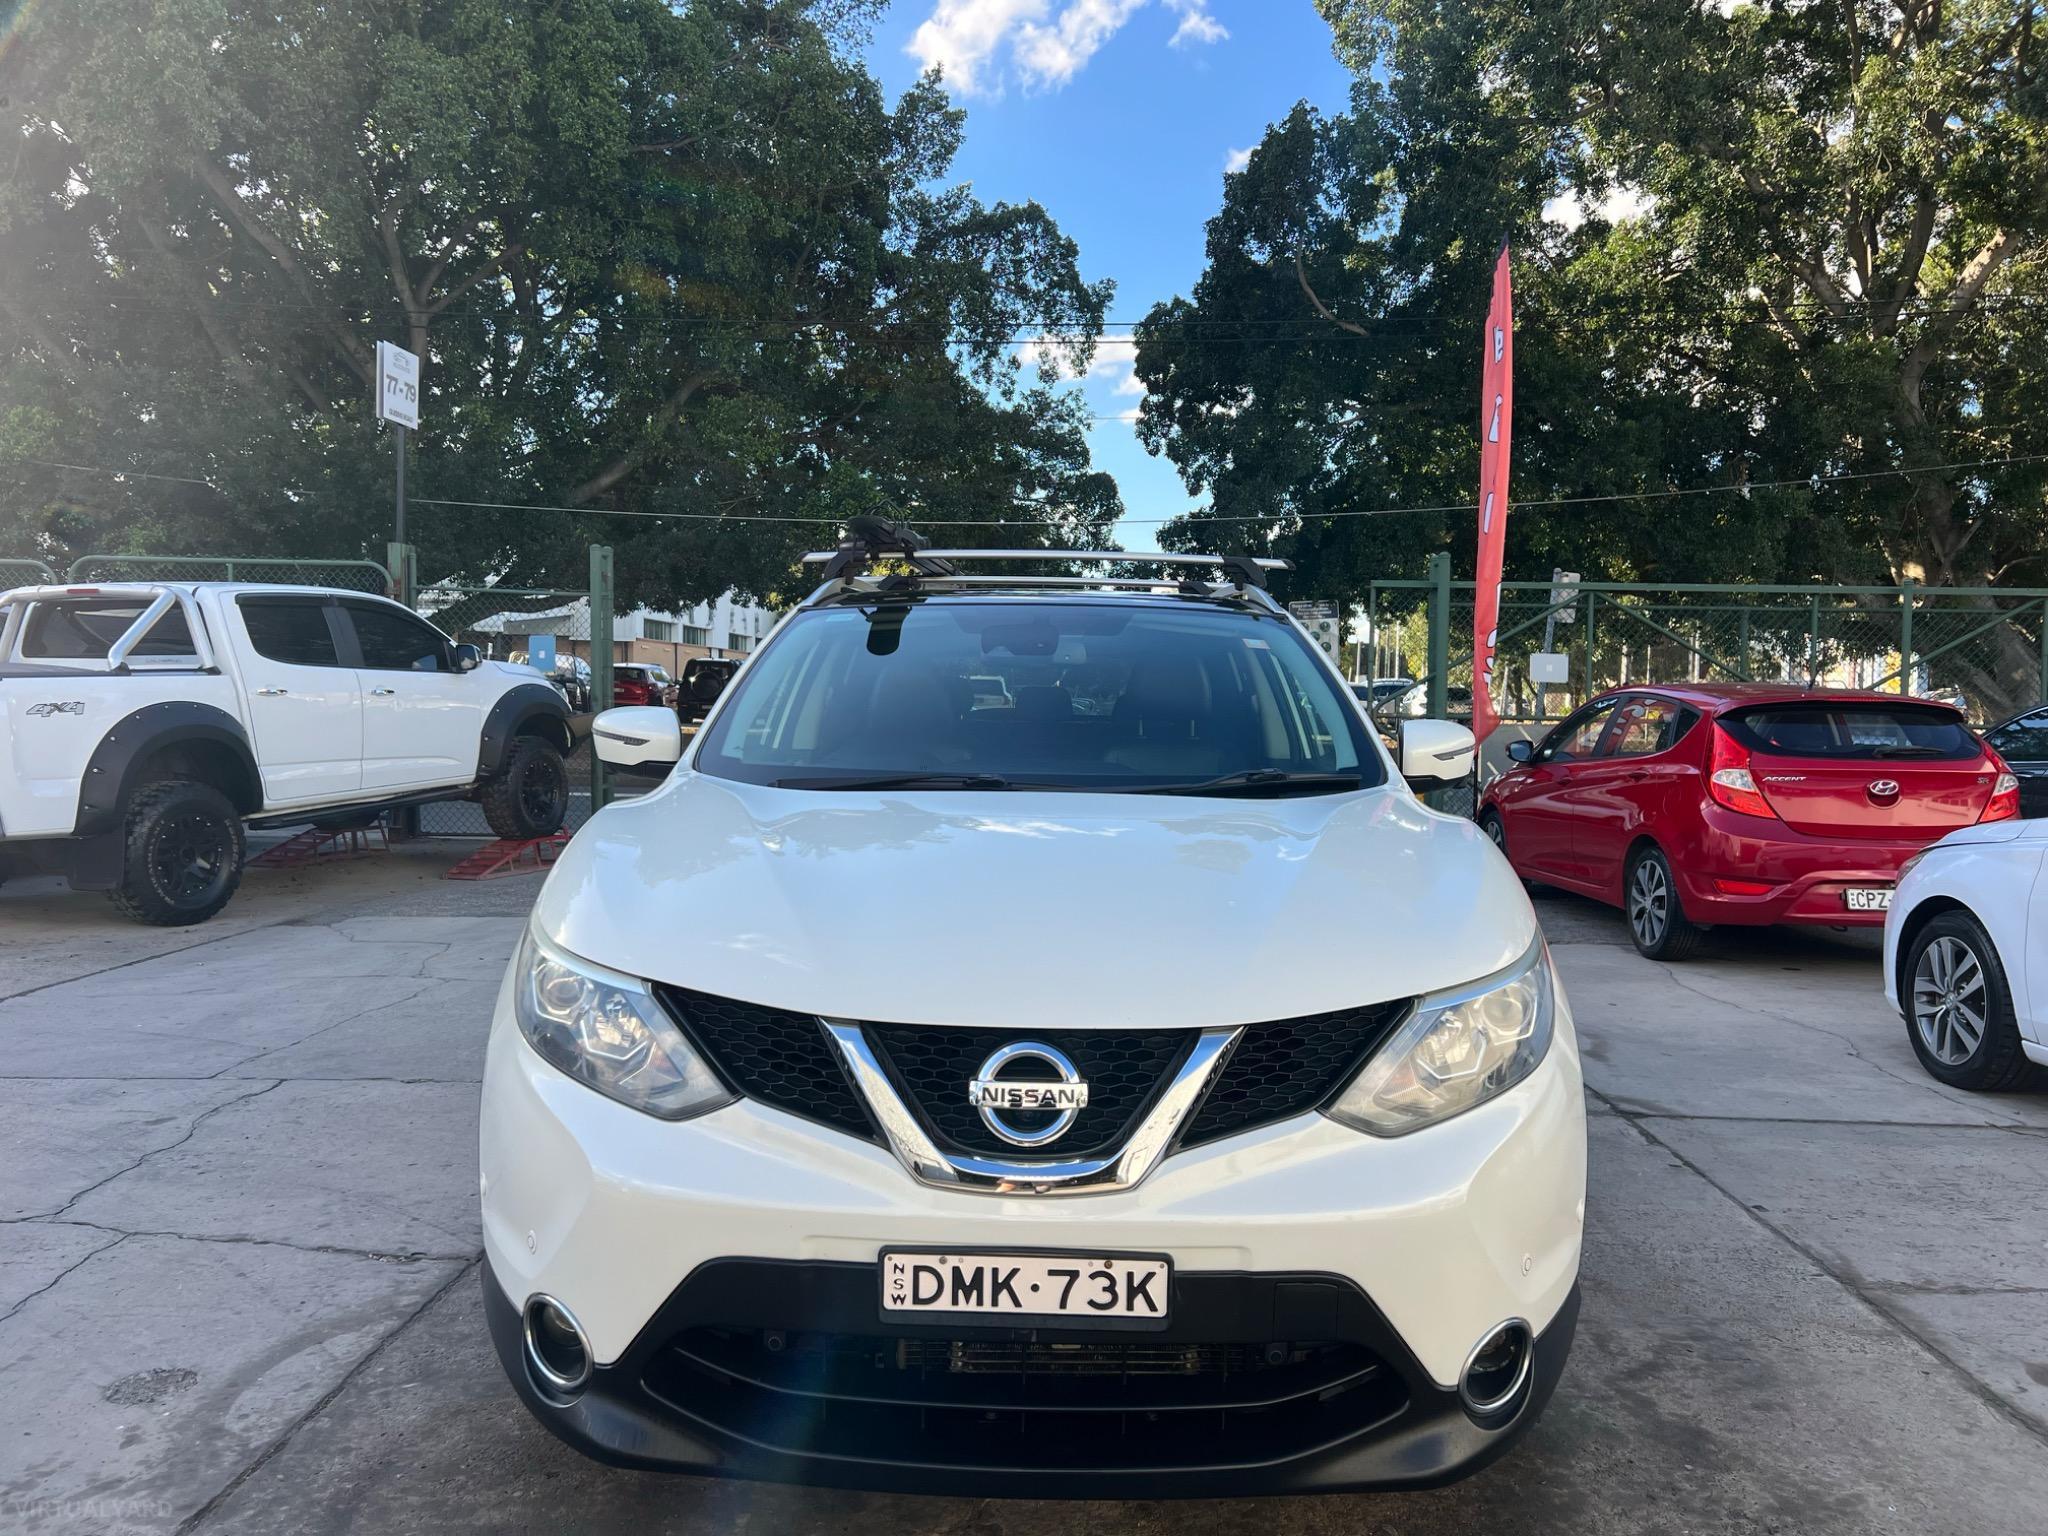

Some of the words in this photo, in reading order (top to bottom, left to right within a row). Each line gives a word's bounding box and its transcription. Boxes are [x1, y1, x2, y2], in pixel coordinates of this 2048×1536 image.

[386, 374, 416, 403] 77-79
[981, 1087, 1075, 1104] NISSAN
[891, 1262, 906, 1306] NSW
